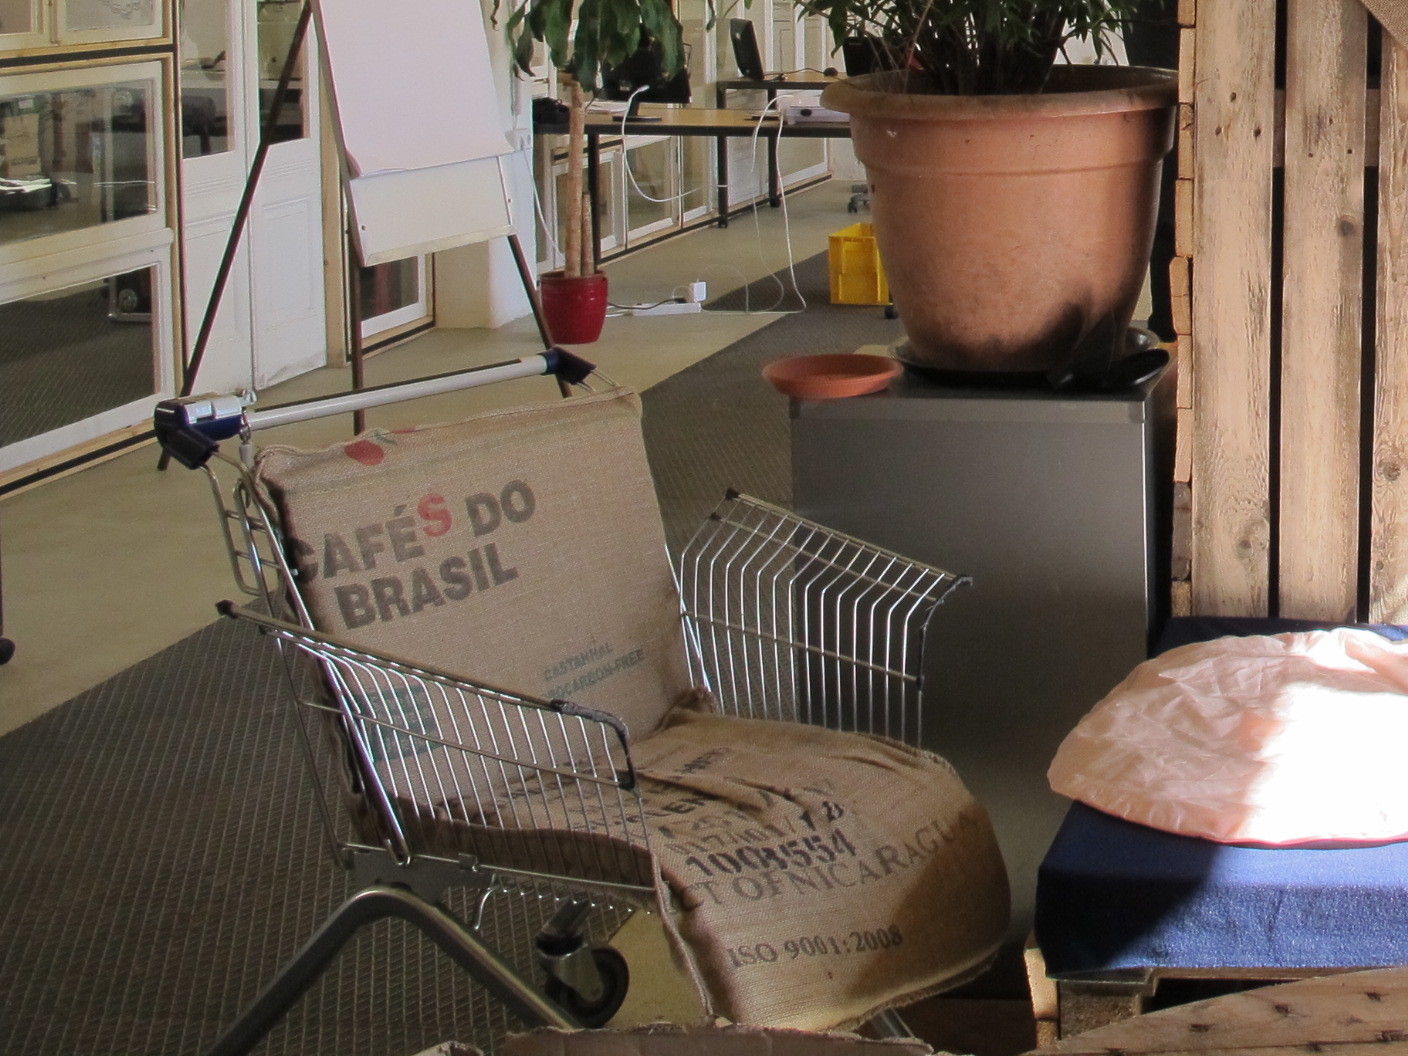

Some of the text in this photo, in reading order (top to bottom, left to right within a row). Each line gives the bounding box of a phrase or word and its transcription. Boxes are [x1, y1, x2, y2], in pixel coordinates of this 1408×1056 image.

[465, 479, 536, 538] DO
[334, 543, 520, 630] BRASIL
[727, 942, 779, 968] ISO
